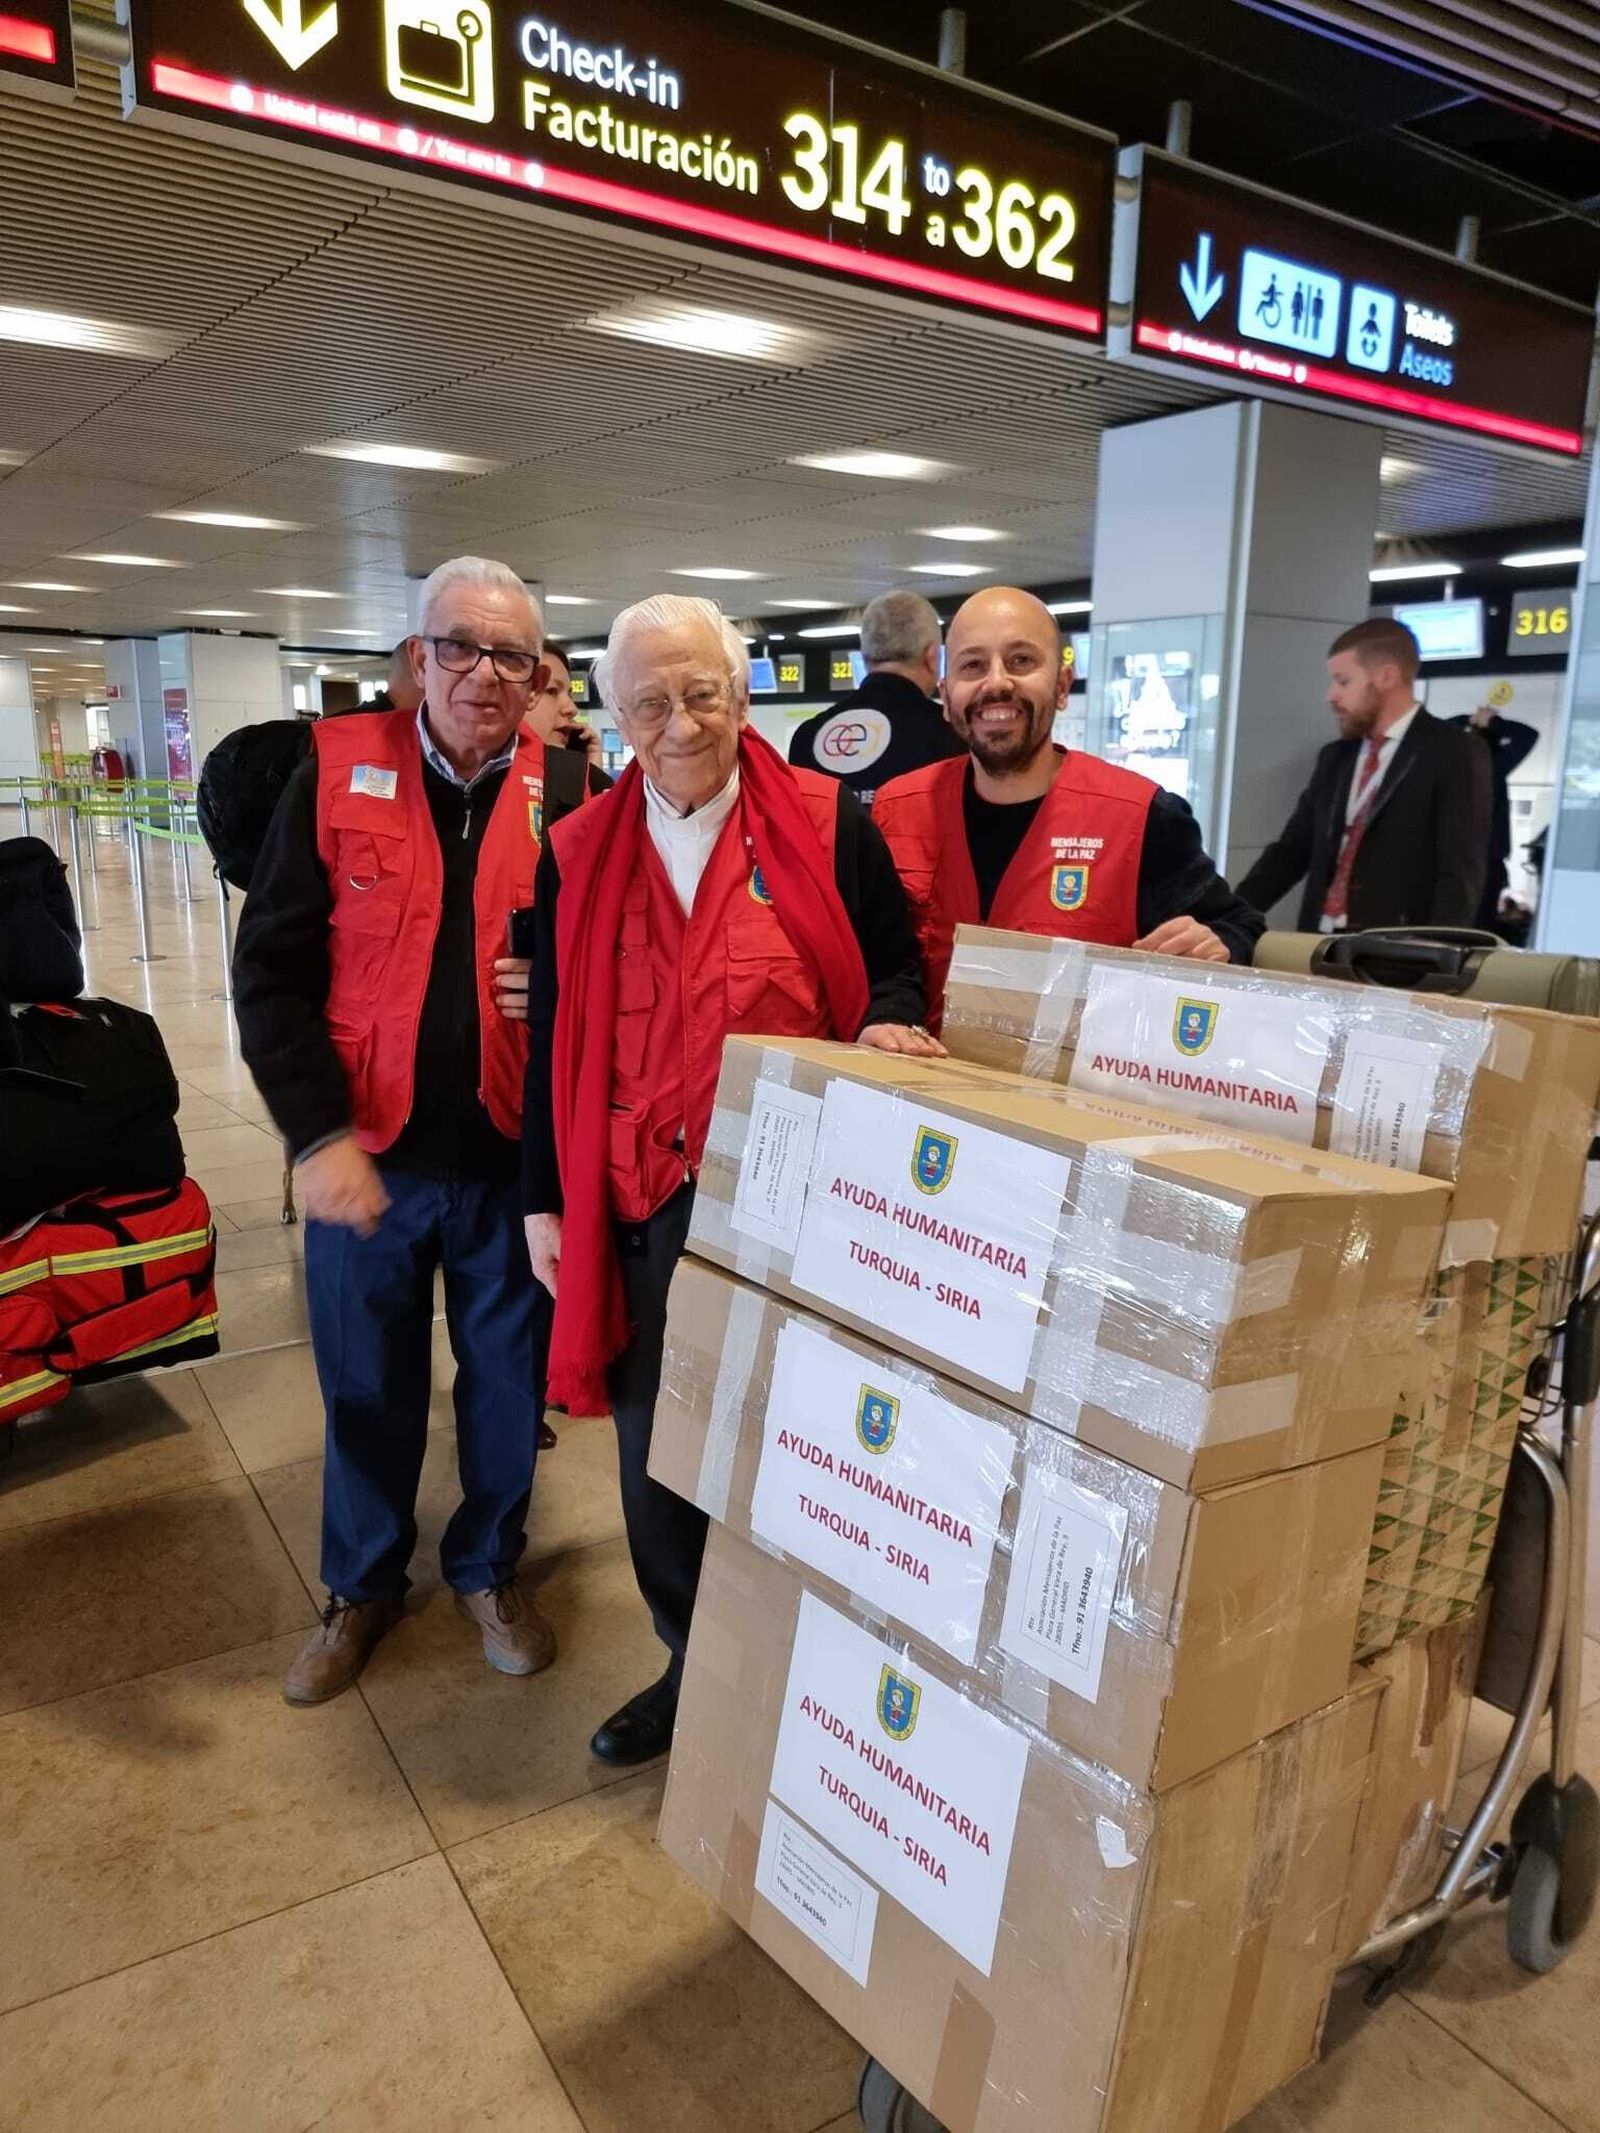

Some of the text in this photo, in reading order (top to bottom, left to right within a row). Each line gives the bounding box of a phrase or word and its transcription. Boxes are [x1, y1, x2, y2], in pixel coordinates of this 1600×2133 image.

[521, 20, 679, 110] Check-in
[524, 79, 758, 195] Facturación
[781, 113, 1076, 283] 314 to a 362
[1399, 343, 1453, 386] Aseos
[1515, 607, 1568, 636] 316
[781, 665, 799, 682] 322
[832, 662, 852, 678] 321
[1050, 837, 1104, 849] MENSAJEROS
[1055, 848, 1096, 860] DE LA PAZ
[1091, 1053, 1299, 1115] AYUDA HUMANITARIA
[830, 1177, 1027, 1280] AYUDA HUMANITARIA
[849, 1240, 921, 1292] TURQUIA
[935, 1283, 981, 1320] SIRIA
[777, 1429, 974, 1549] AYUDA HUMANITARIA
[799, 1493, 871, 1552] TURQUIA
[885, 1544, 931, 1586] SIRIA
[1076, 1611, 1085, 1626] 91
[1078, 1565, 1093, 1611] 3643940
[799, 1695, 855, 1752] AYUDA
[859, 1739, 991, 1858] HUMANITARIA
[819, 1765, 890, 1841] TURQUIA
[903, 1836, 948, 1887] SIRIA
